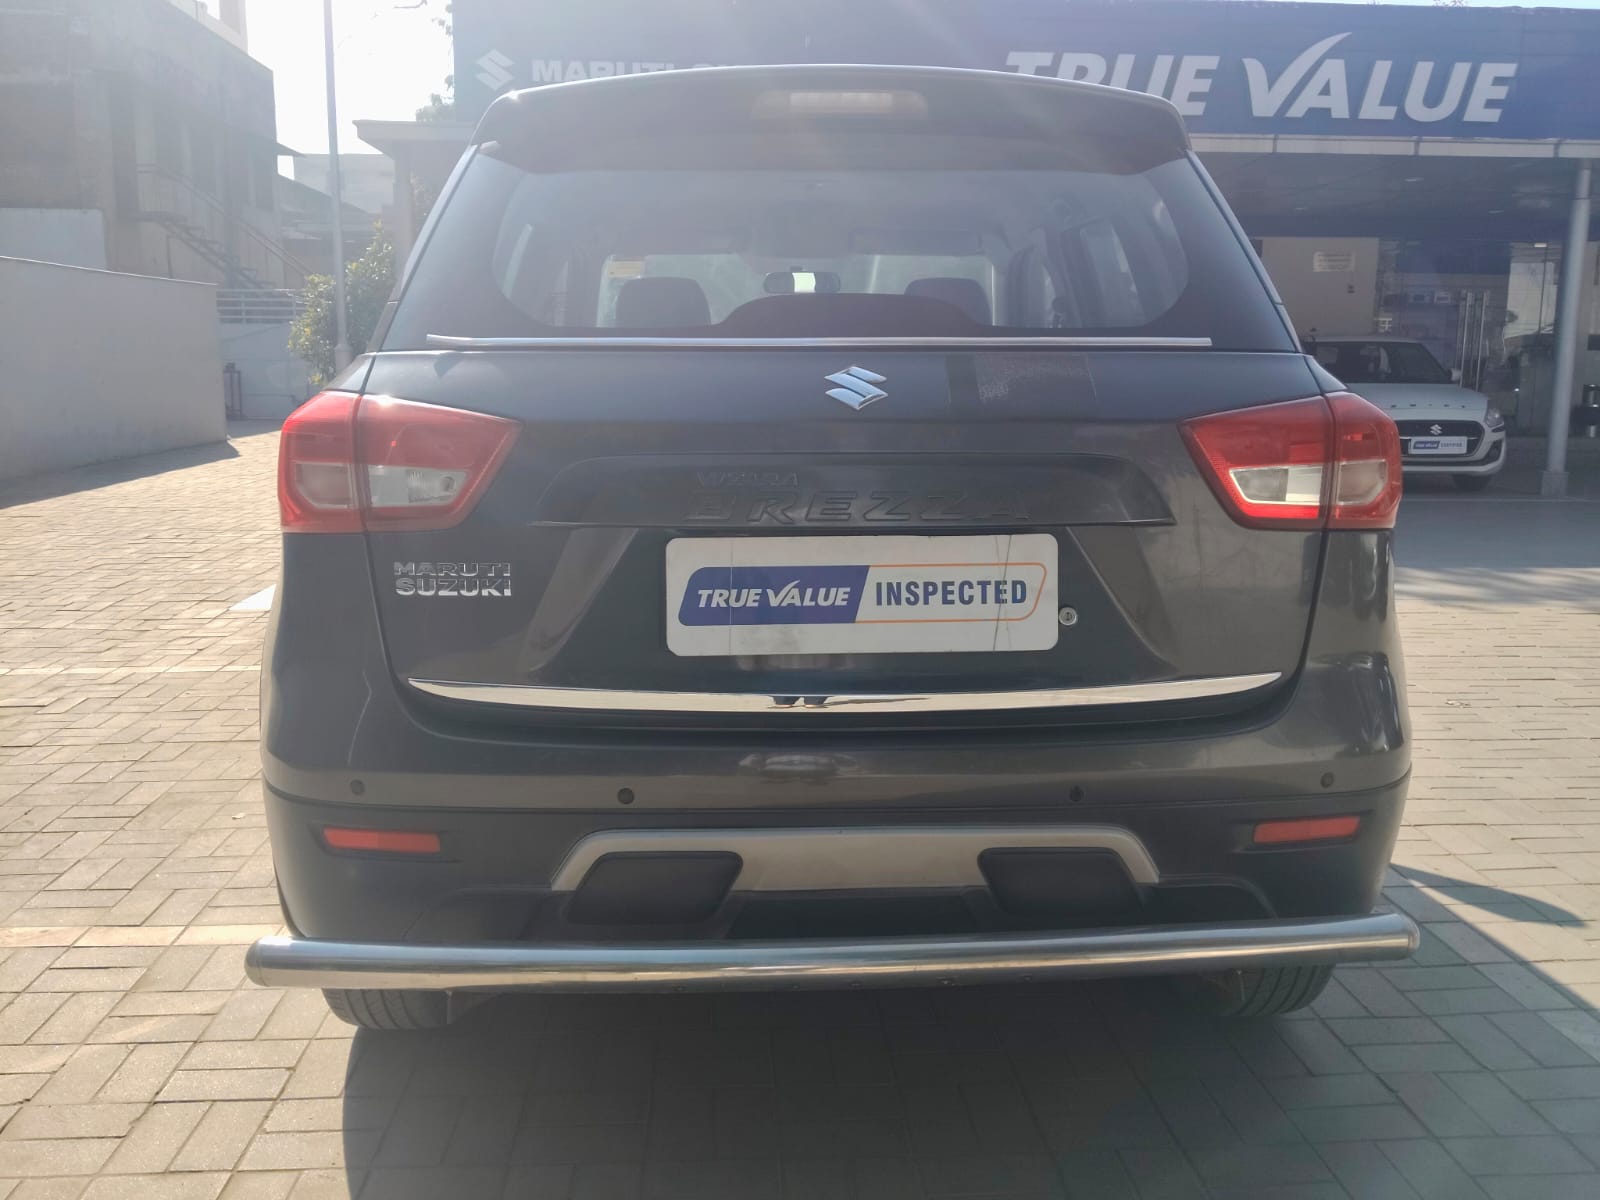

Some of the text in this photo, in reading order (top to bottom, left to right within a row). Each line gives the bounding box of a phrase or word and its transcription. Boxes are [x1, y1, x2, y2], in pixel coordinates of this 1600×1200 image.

[1241, 32, 1518, 123] VALUE
[393, 561, 511, 577] MARUTI
[395, 577, 512, 597] SUZUKI
[698, 579, 1028, 607] TRUE VALUE INSPECTED
